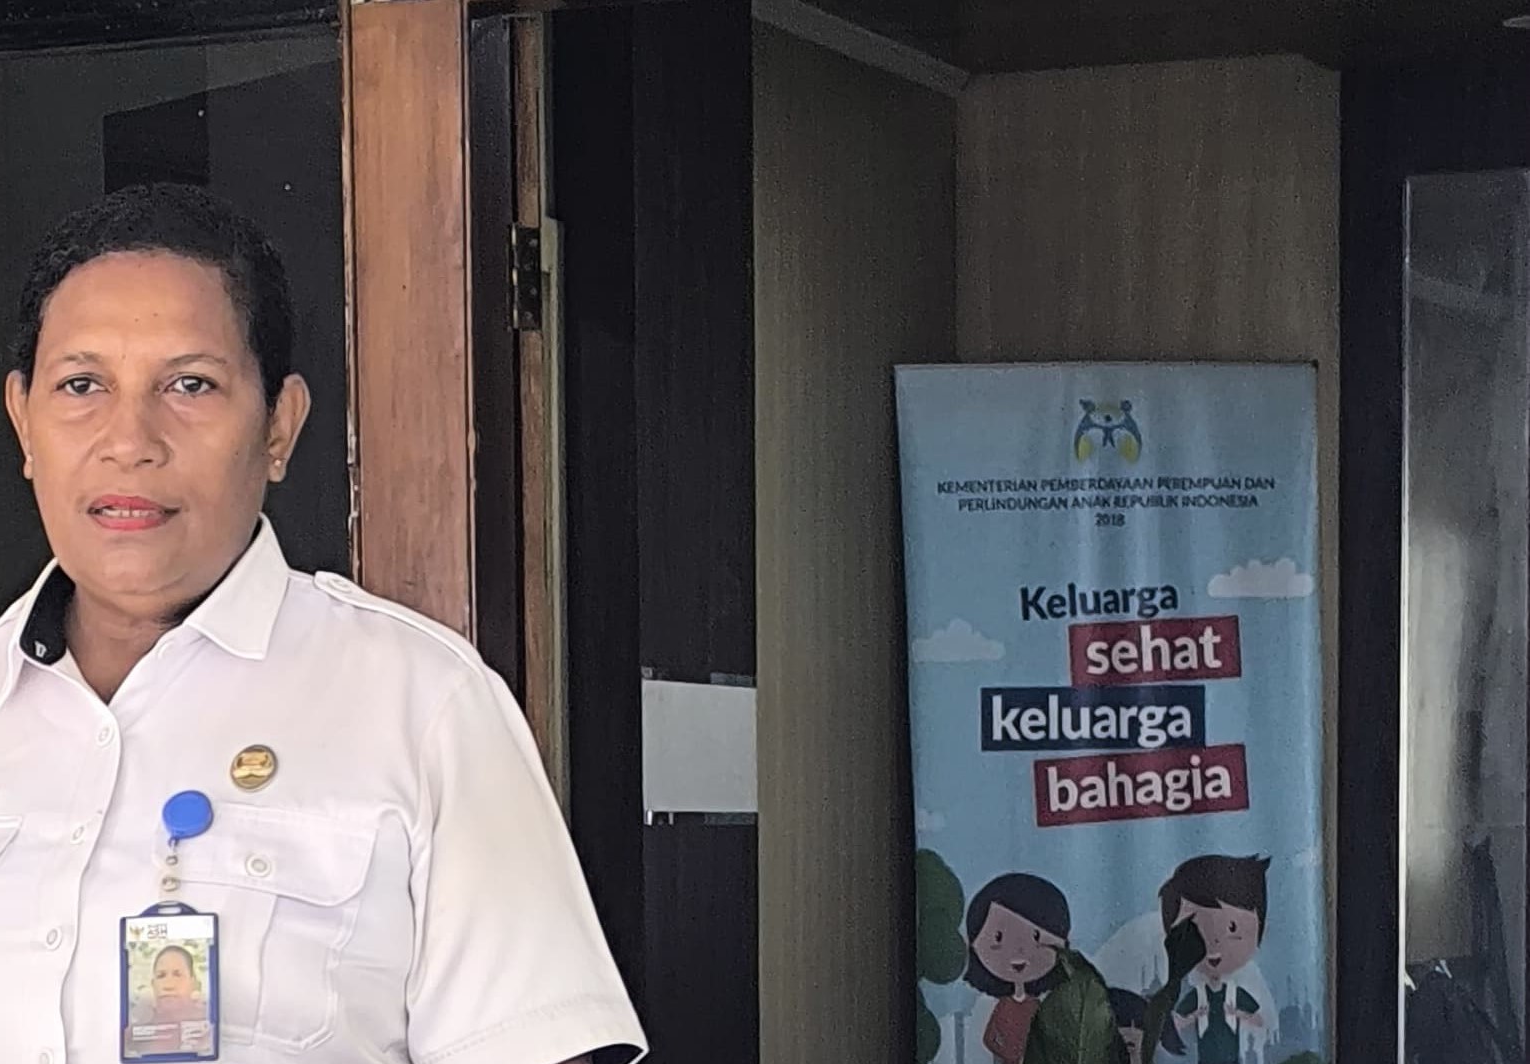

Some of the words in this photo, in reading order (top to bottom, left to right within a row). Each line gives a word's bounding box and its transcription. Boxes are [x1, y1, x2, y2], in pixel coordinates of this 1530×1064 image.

[936, 478, 1038, 494] KEMENTERIAN
[1040, 476, 1154, 493] PEMBERDAYAAN
[1244, 476, 1276, 490] DAN
[958, 496, 1069, 512] PERLINDUNGAN
[1071, 494, 1111, 509] ANAK
[1113, 493, 1179, 509] REPUBLIK
[1181, 493, 1259, 508] INDONESIA
[1094, 512, 1126, 527] 2018
[1020, 582, 1179, 621] Keluarga
[1086, 624, 1223, 675] sehat
[991, 694, 1192, 748] keluarga
[1047, 754, 1232, 812] bahagia
